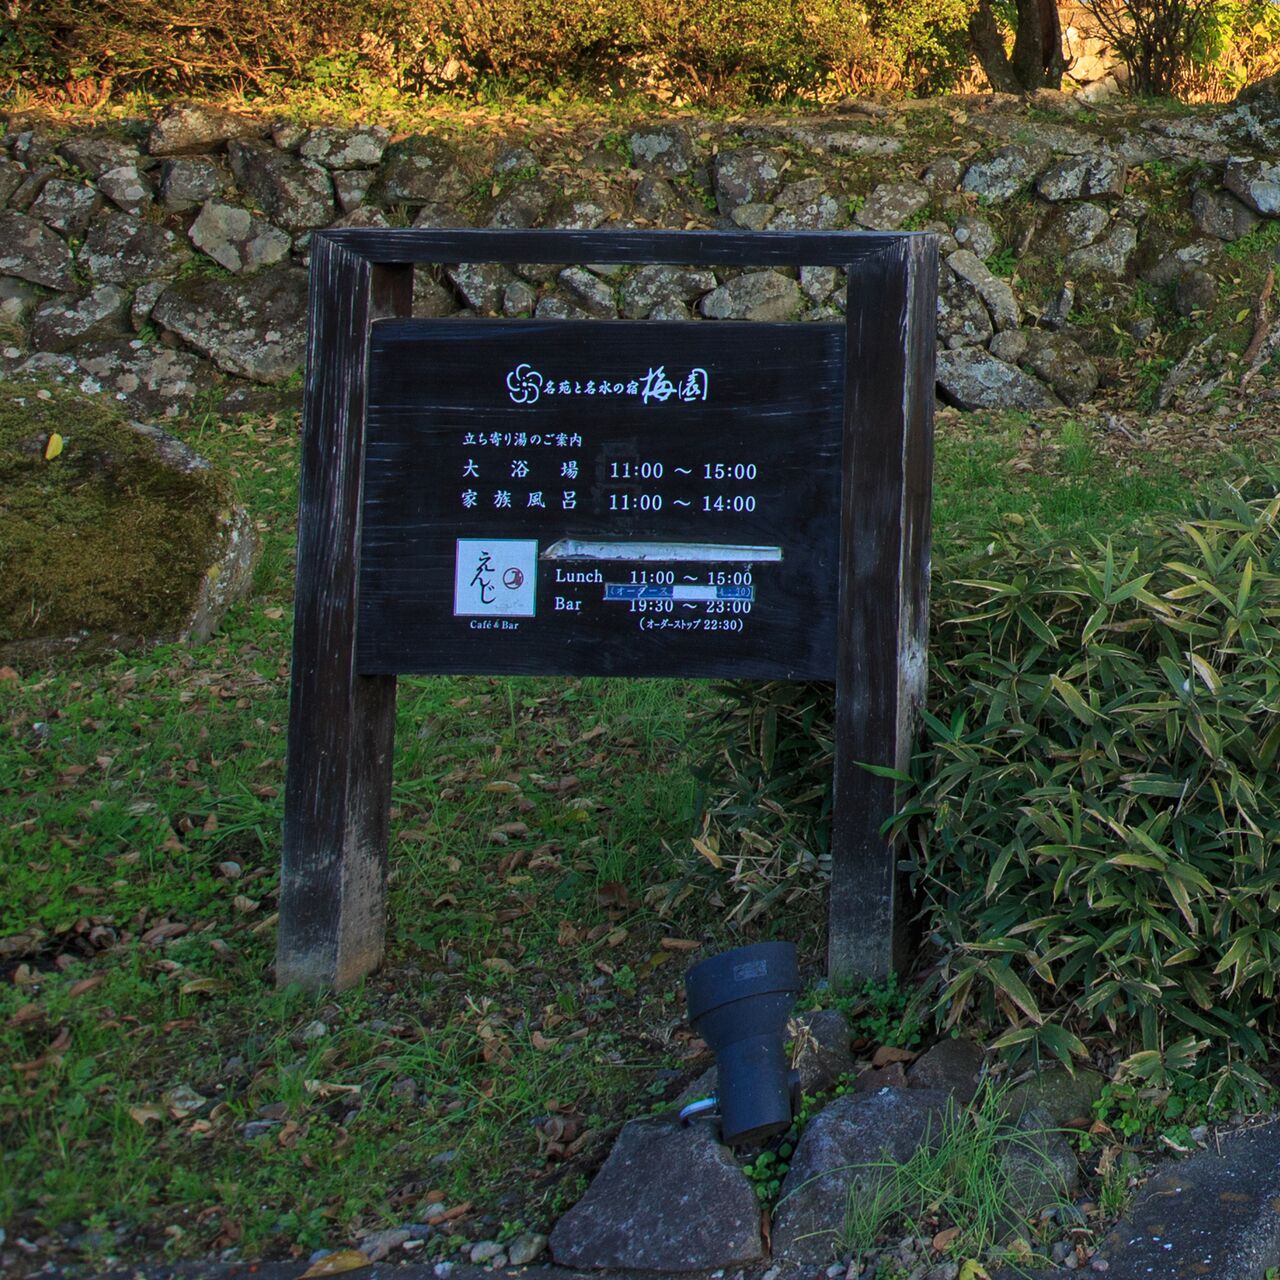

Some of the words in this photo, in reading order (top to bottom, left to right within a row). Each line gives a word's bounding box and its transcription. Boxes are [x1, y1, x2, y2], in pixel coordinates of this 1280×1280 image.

[542, 380, 640, 395] 名苑と名水の宿
[639, 365, 709, 405] 梅園
[462, 431, 583, 448] 立ち寄り湯のご案内
[461, 459, 580, 480] 大浴場
[609, 462, 664, 480] 11:00
[703, 463, 757, 481] 15:00
[461, 489, 578, 511] 家族風呂
[608, 494, 663, 512] 11:00
[702, 495, 757, 513] 14:00
[470, 550, 497, 604] えんじ
[555, 568, 603, 584] Lunch
[630, 570, 675, 585] 11:00
[707, 571, 753, 586] 15:00
[554, 596, 583, 611] Bar
[629, 599, 674, 613] 19:30
[706, 599, 752, 614] 23:00
[469, 619, 492, 630] Café
[501, 621, 520, 631] Bar
